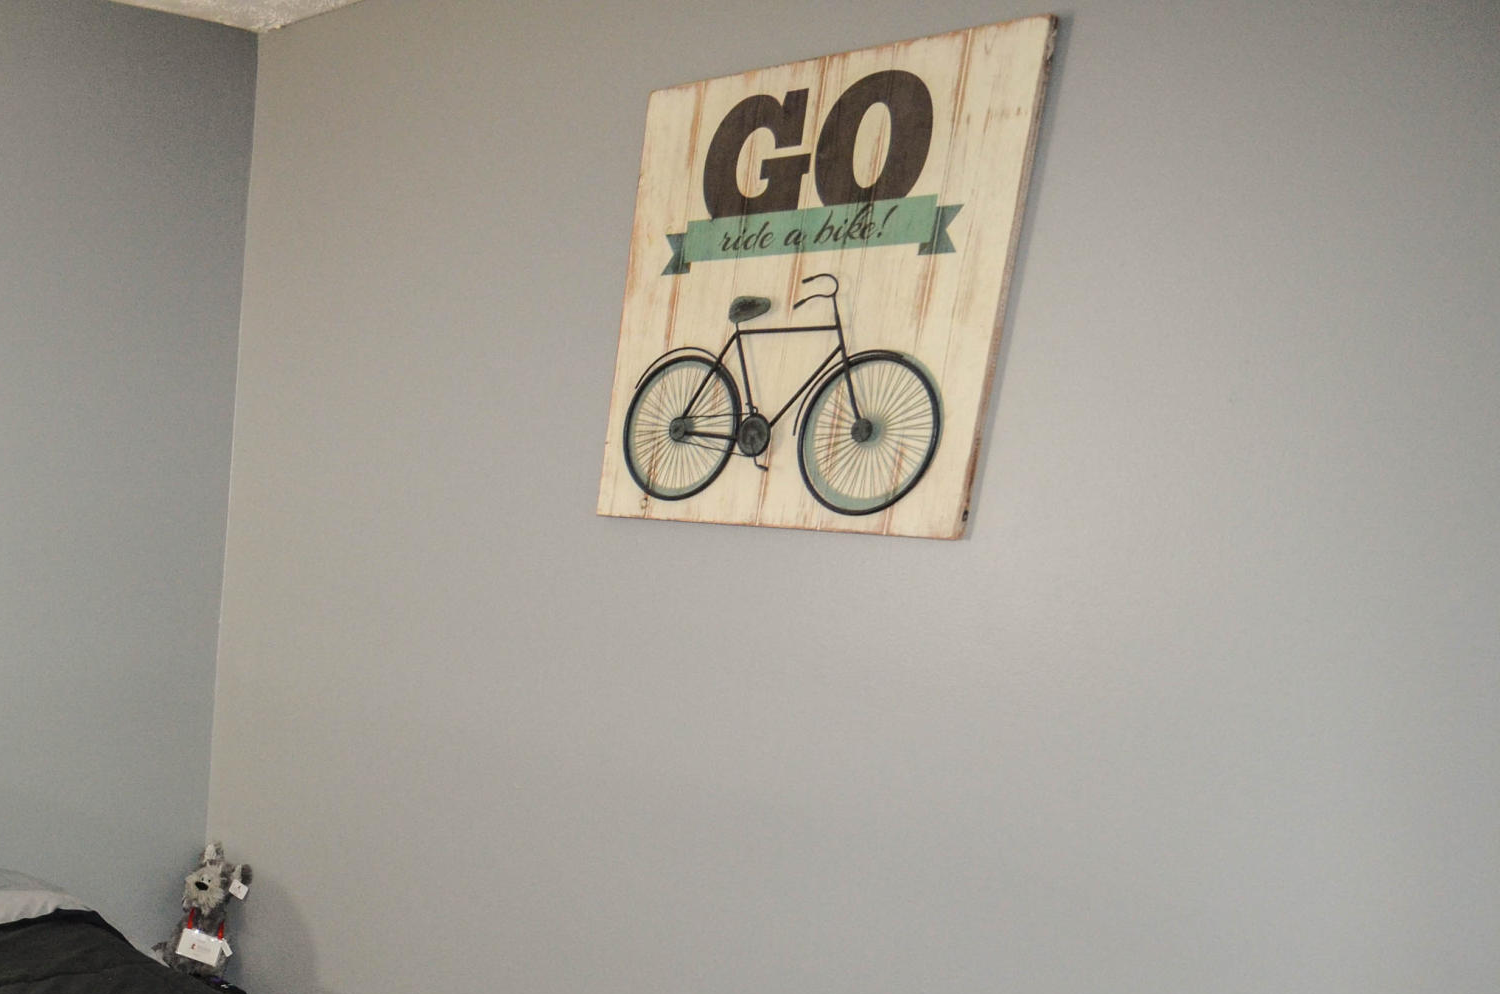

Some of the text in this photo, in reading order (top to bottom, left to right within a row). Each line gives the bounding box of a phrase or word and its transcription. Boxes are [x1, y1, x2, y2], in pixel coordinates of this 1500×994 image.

[703, 69, 933, 219] GO
[720, 203, 898, 252] ride a bike!
